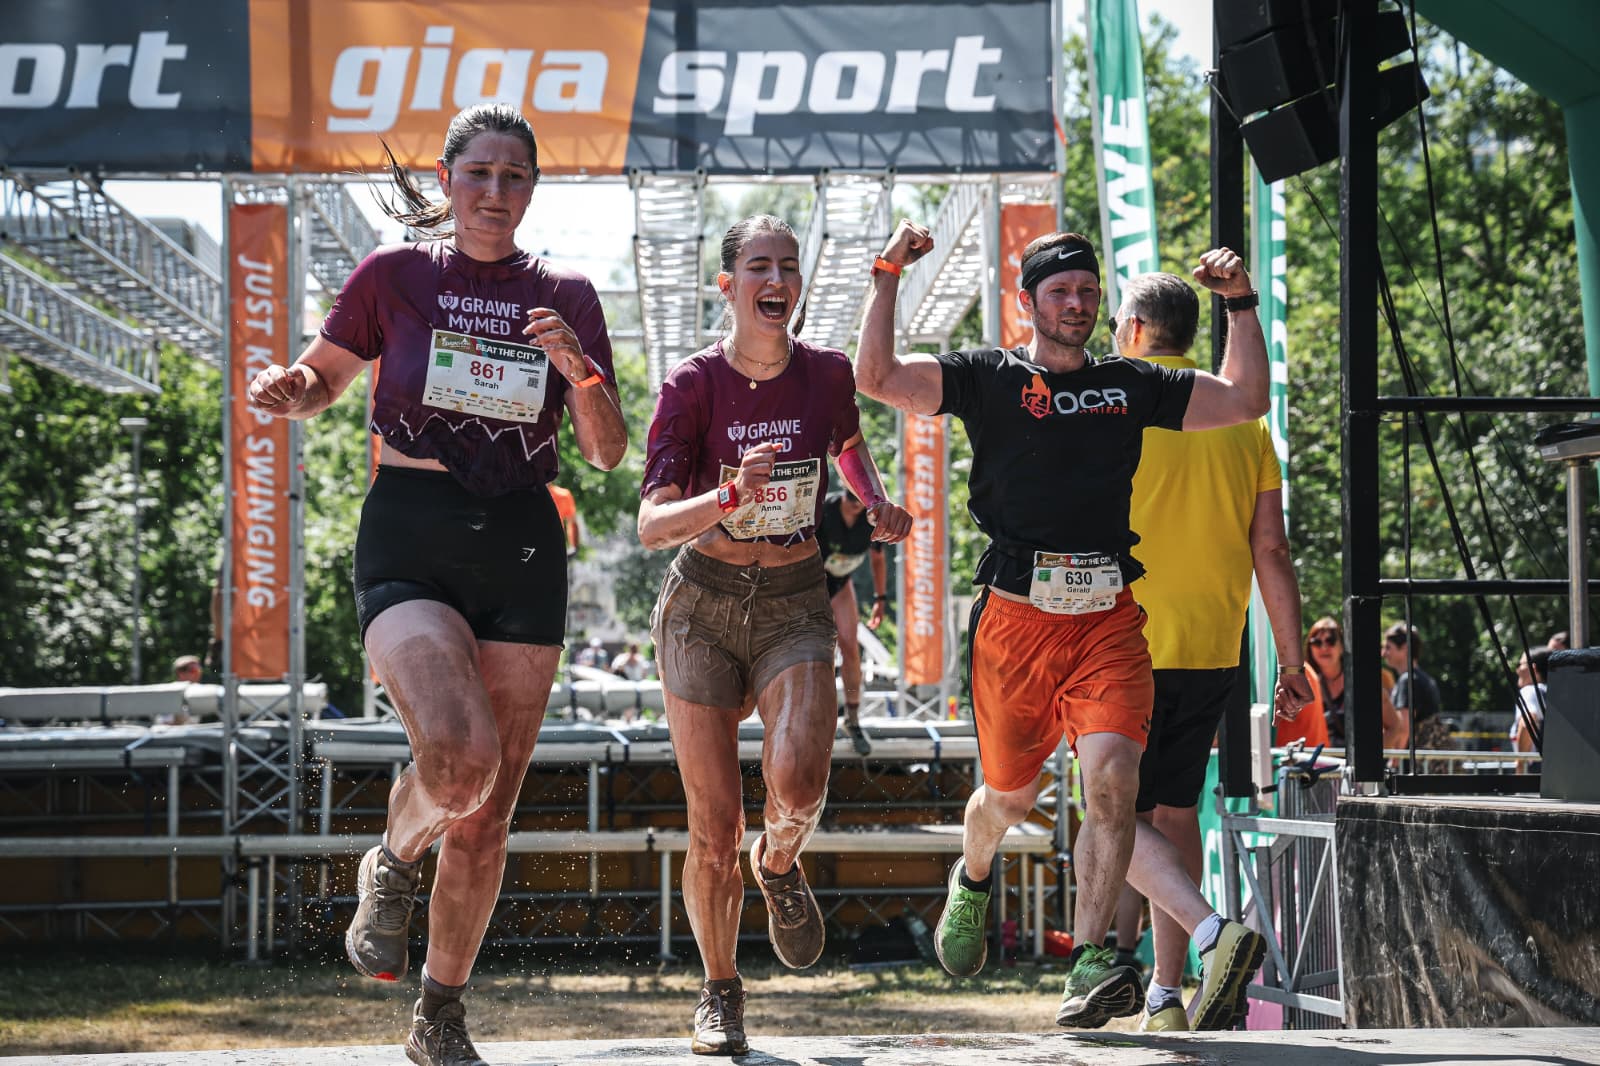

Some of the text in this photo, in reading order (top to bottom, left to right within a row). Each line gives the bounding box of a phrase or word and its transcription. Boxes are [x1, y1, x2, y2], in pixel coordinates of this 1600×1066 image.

[0, 31, 187, 109] ort
[327, 26, 1002, 135] giga sport
[461, 297, 520, 319] GRAWE
[448, 313, 511, 335] MyMED
[475, 343, 499, 355] BEAT
[499, 348, 515, 358] THE
[516, 350, 537, 361] CITY
[470, 360, 505, 381] 861
[474, 378, 499, 390] Sarah
[1054, 388, 1128, 414] OCR
[238, 254, 275, 608] JUST KP SWINGING
[747, 419, 801, 440] GRAWE
[738, 437, 792, 459] MED
[777, 465, 810, 476] THE CITY
[914, 453, 935, 510] KEEP
[755, 486, 788, 504] 856
[914, 517, 935, 637] SWINGING
[1065, 571, 1092, 585] 630
